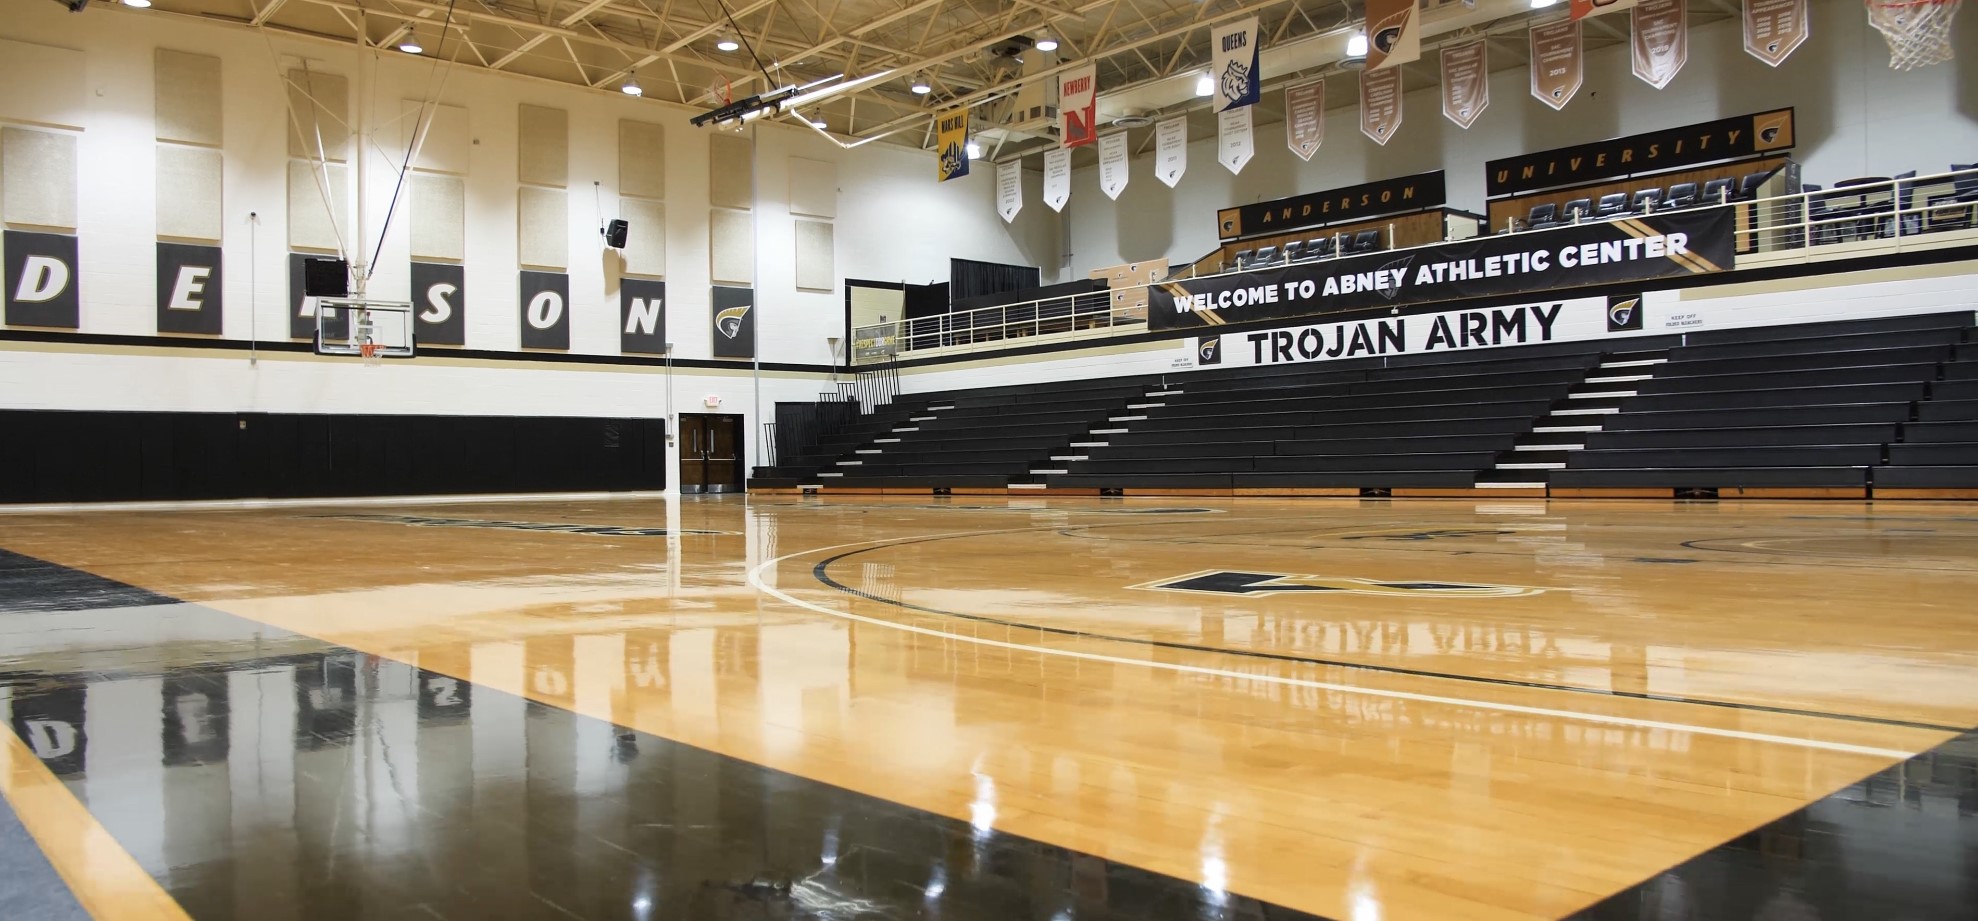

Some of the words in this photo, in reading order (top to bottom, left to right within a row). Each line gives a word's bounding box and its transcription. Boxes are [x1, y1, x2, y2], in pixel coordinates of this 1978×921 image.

[1222, 30, 1247, 52] QUEENS
[1063, 75, 1090, 97] NEWBERRY
[941, 117, 954, 134] MARS
[954, 114, 964, 130] HILL
[1497, 129, 1741, 183] UNIVERSITY
[1263, 187, 1414, 223] ANDERSON
[1173, 284, 1279, 314] WELCOME
[1284, 279, 1316, 301] TO
[1322, 267, 1408, 297] ABNEY
[1414, 250, 1550, 285] ATHLETIC
[1558, 232, 1688, 268] CENTER
[1247, 318, 1405, 364] TROJAN
[1425, 303, 1563, 351] ARMY
[709, 396, 718, 404] EXIT
